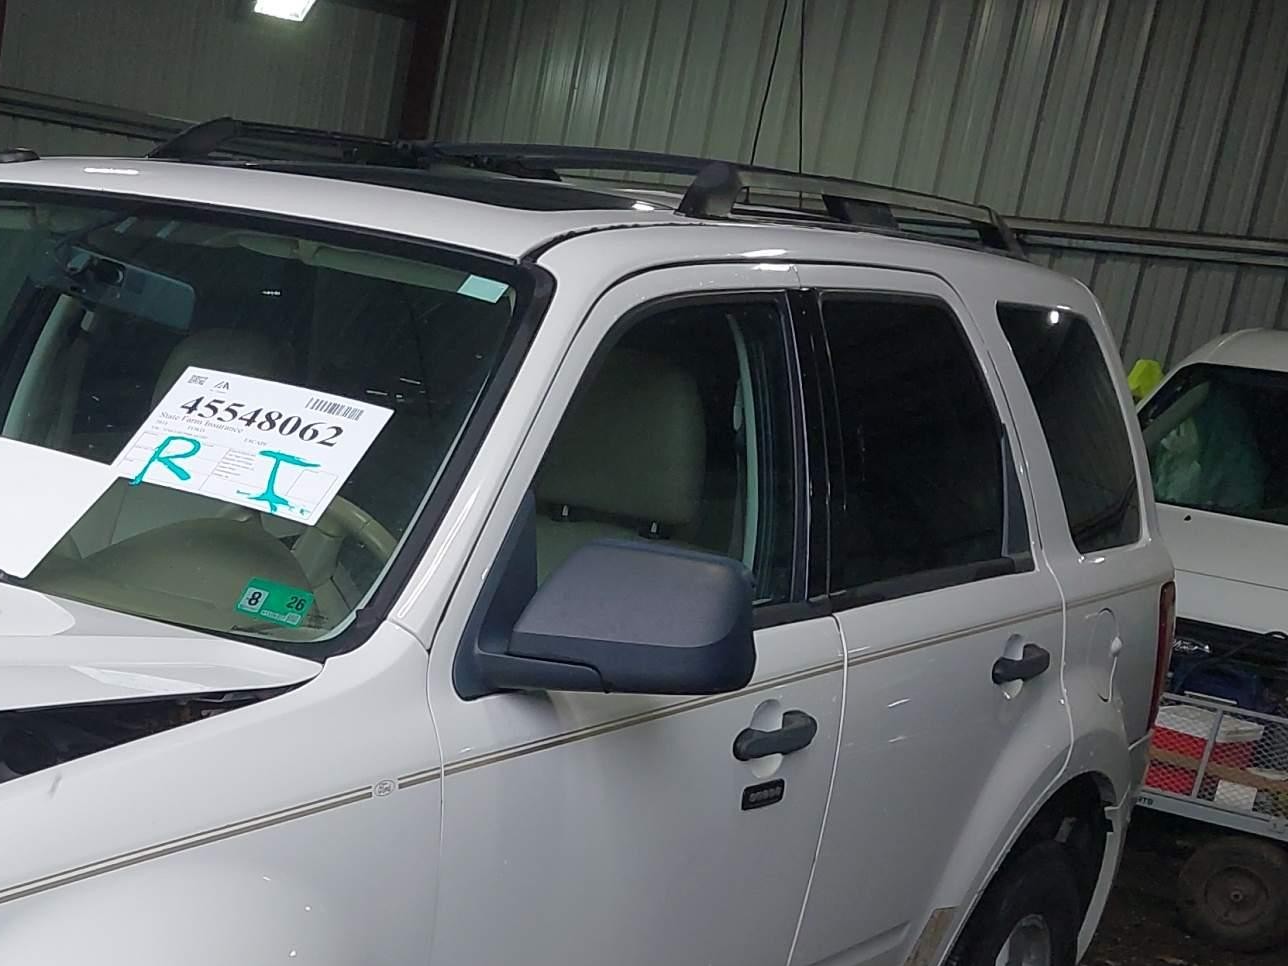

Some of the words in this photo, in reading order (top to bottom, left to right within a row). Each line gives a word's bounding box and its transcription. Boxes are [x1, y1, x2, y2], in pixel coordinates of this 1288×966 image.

[158, 411, 181, 421] State
[181, 414, 203, 425] Farm
[204, 420, 244, 433] Insurance
[180, 396, 344, 447] 45548062
[129, 435, 201, 486] R
[248, 450, 321, 514] I
[248, 591, 262, 606] 8
[286, 596, 306, 611] 26
